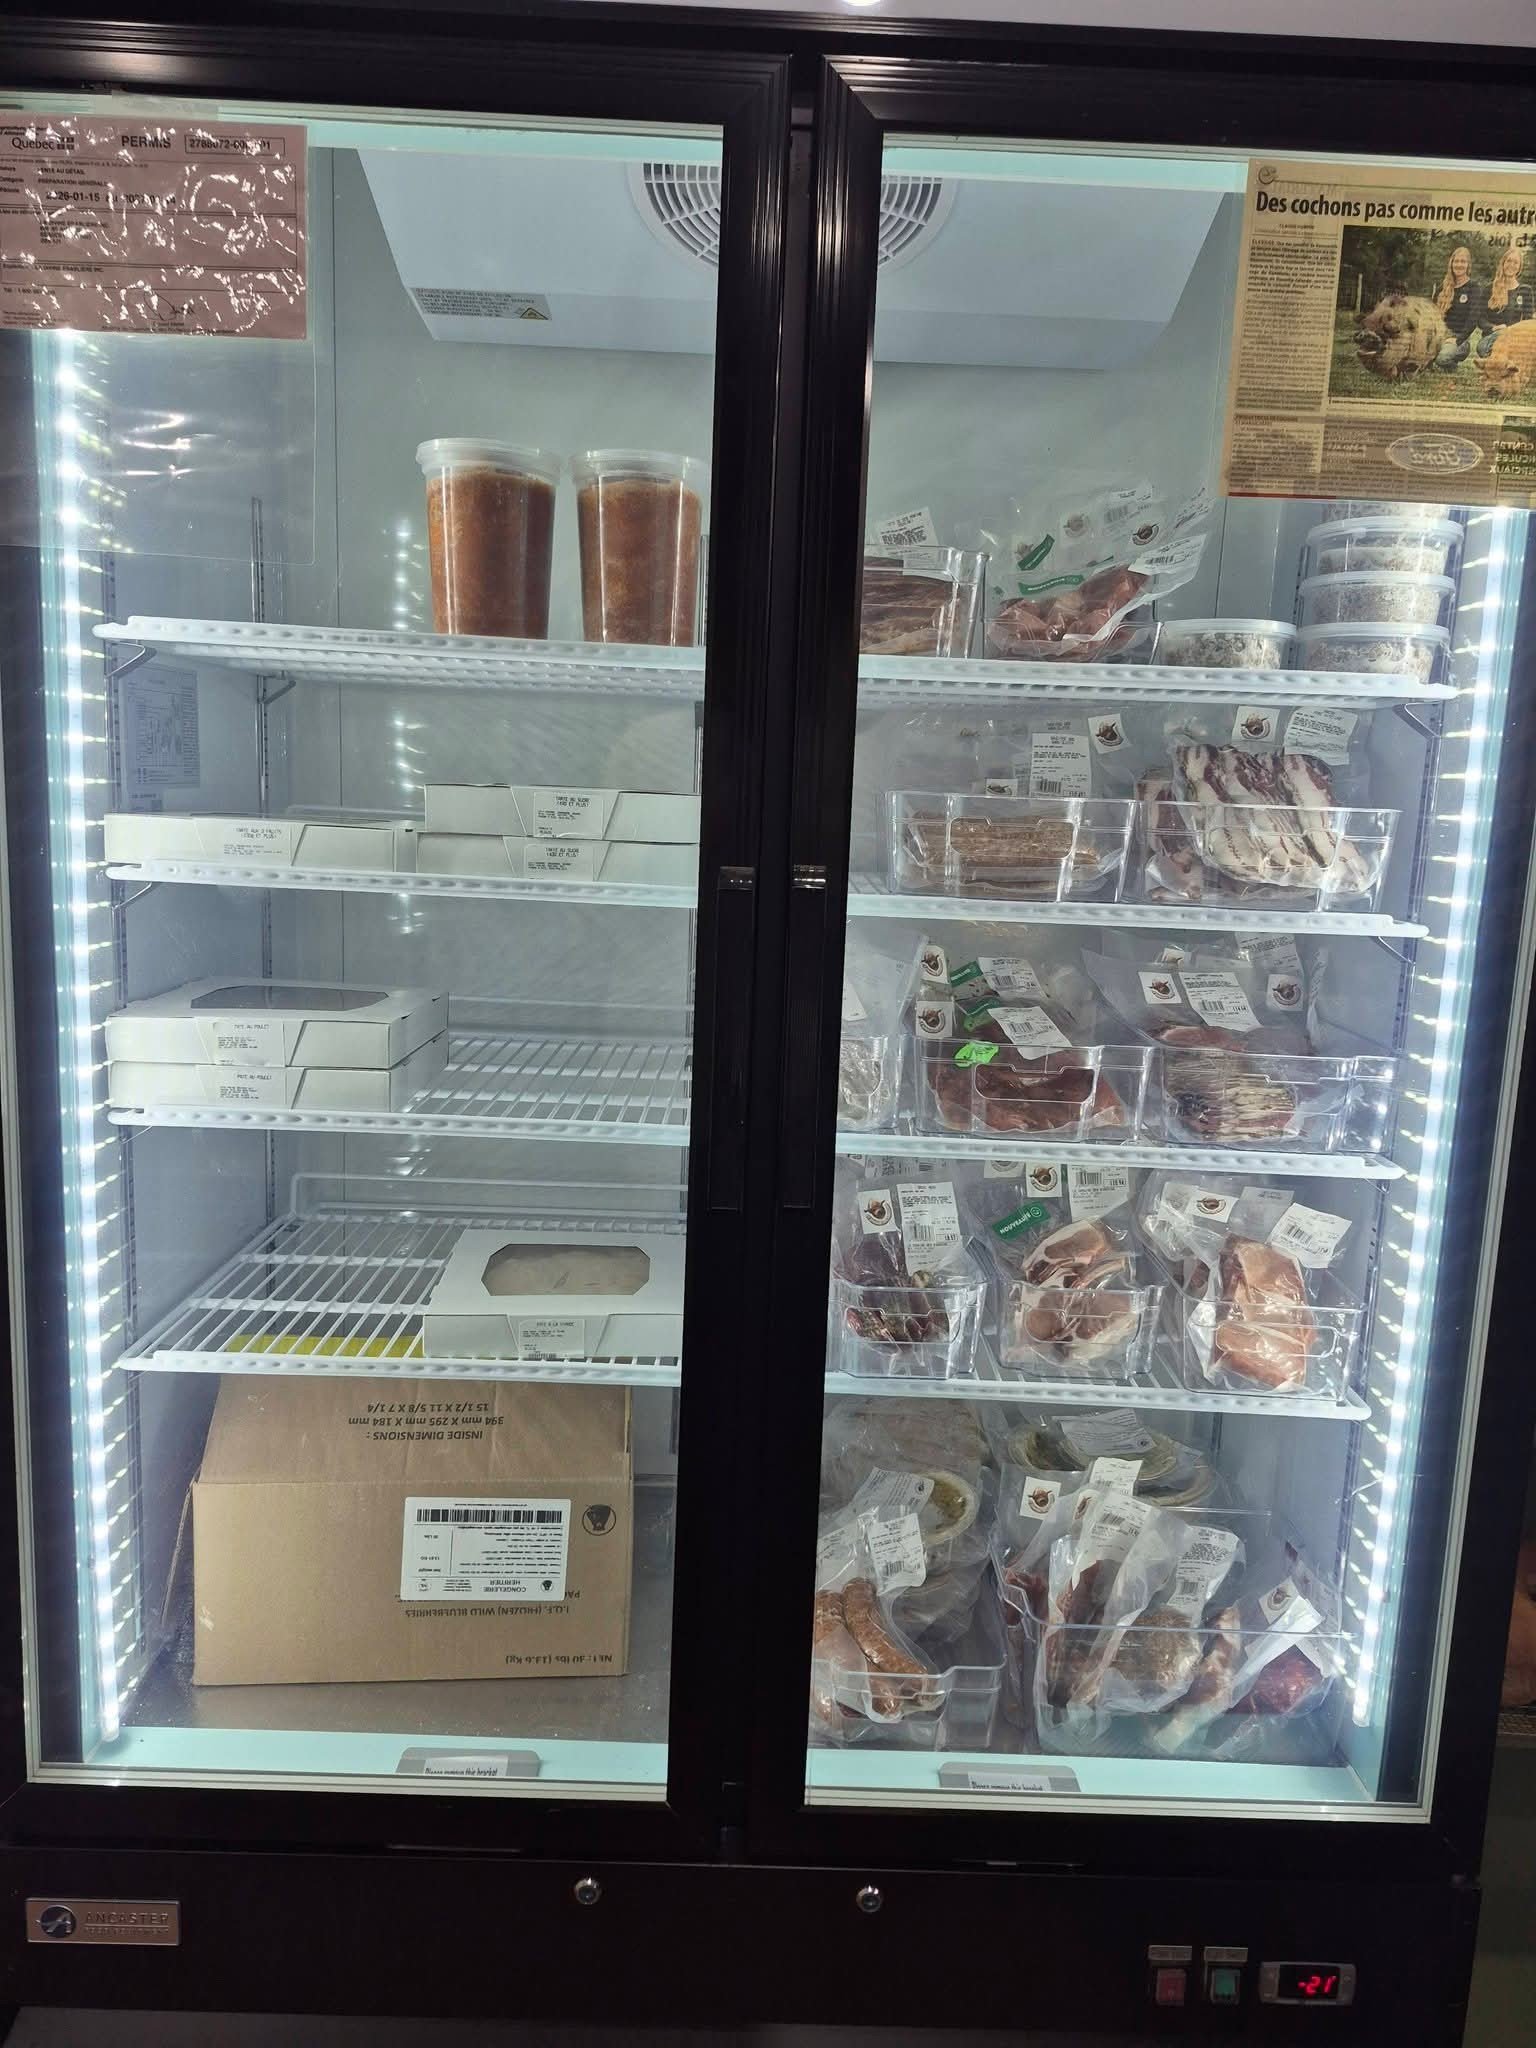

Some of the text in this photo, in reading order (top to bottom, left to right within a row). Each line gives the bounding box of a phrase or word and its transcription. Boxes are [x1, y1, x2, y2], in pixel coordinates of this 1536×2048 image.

[121, 135, 172, 149] PERMIS
[46, 191, 100, 202] 226-01-15
[1256, 191, 1536, 225] Des cochons pas comme les autr
[368, 1402, 385, 1413] 1/4
[389, 1404, 397, 1413] 7
[398, 1404, 405, 1412] X
[408, 1402, 426, 1413] 5/8
[445, 1403, 453, 1412] X
[455, 1402, 473, 1412] 1/2
[348, 1415, 504, 1426] 394 mm X 295 mm X 184 mm
[373, 1431, 444, 1441] DIMENSIONS
[447, 1430, 483, 1440] INSIDE
[405, 1608, 467, 1617] BLUEBERRIES
[470, 1607, 495, 1616] WILD
[498, 1606, 542, 1616] (FROZEN)
[86, 1911, 169, 1925] ANCASTER
